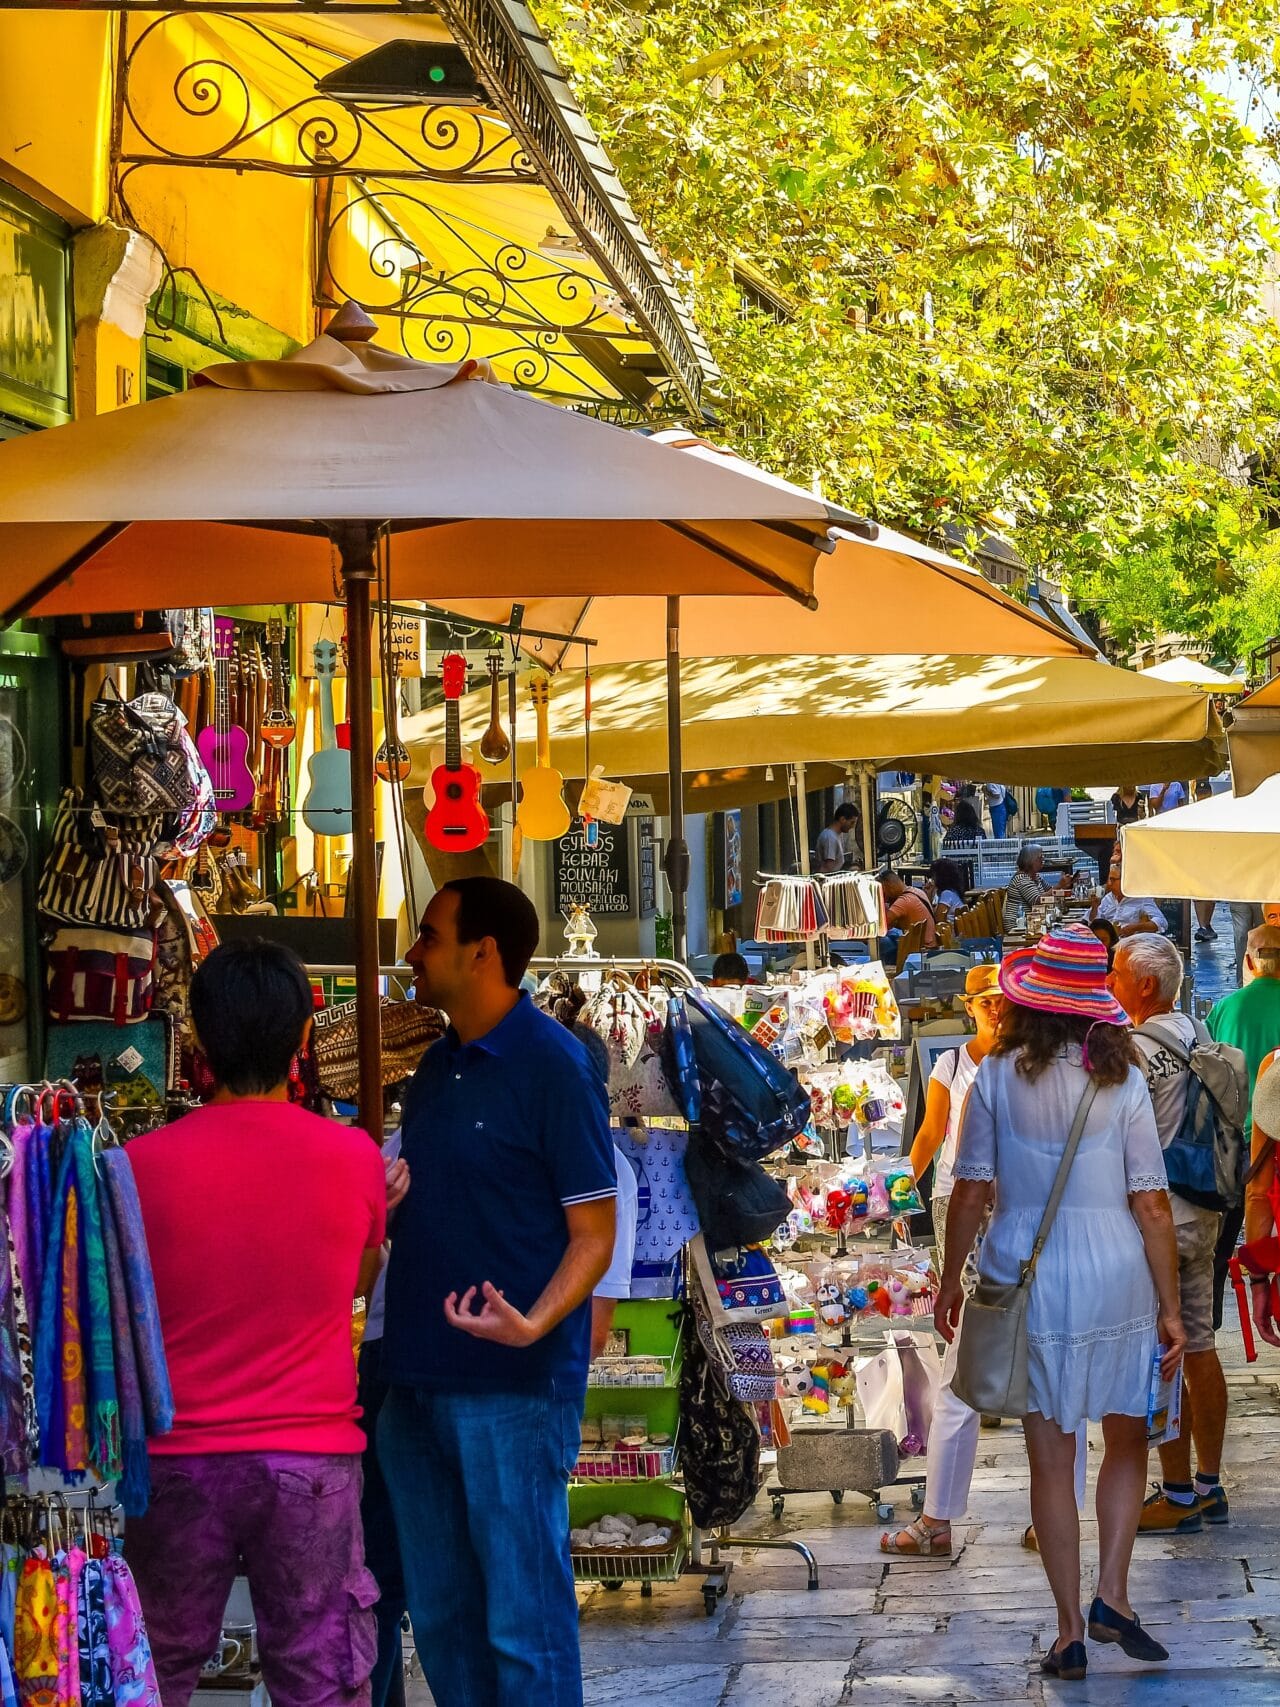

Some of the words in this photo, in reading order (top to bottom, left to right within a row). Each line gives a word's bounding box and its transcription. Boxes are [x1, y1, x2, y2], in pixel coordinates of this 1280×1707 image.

[562, 852, 610, 868] KEBAB
[559, 867, 619, 883] SOUVLAKI
[560, 881, 613, 895] MOUSAKA
